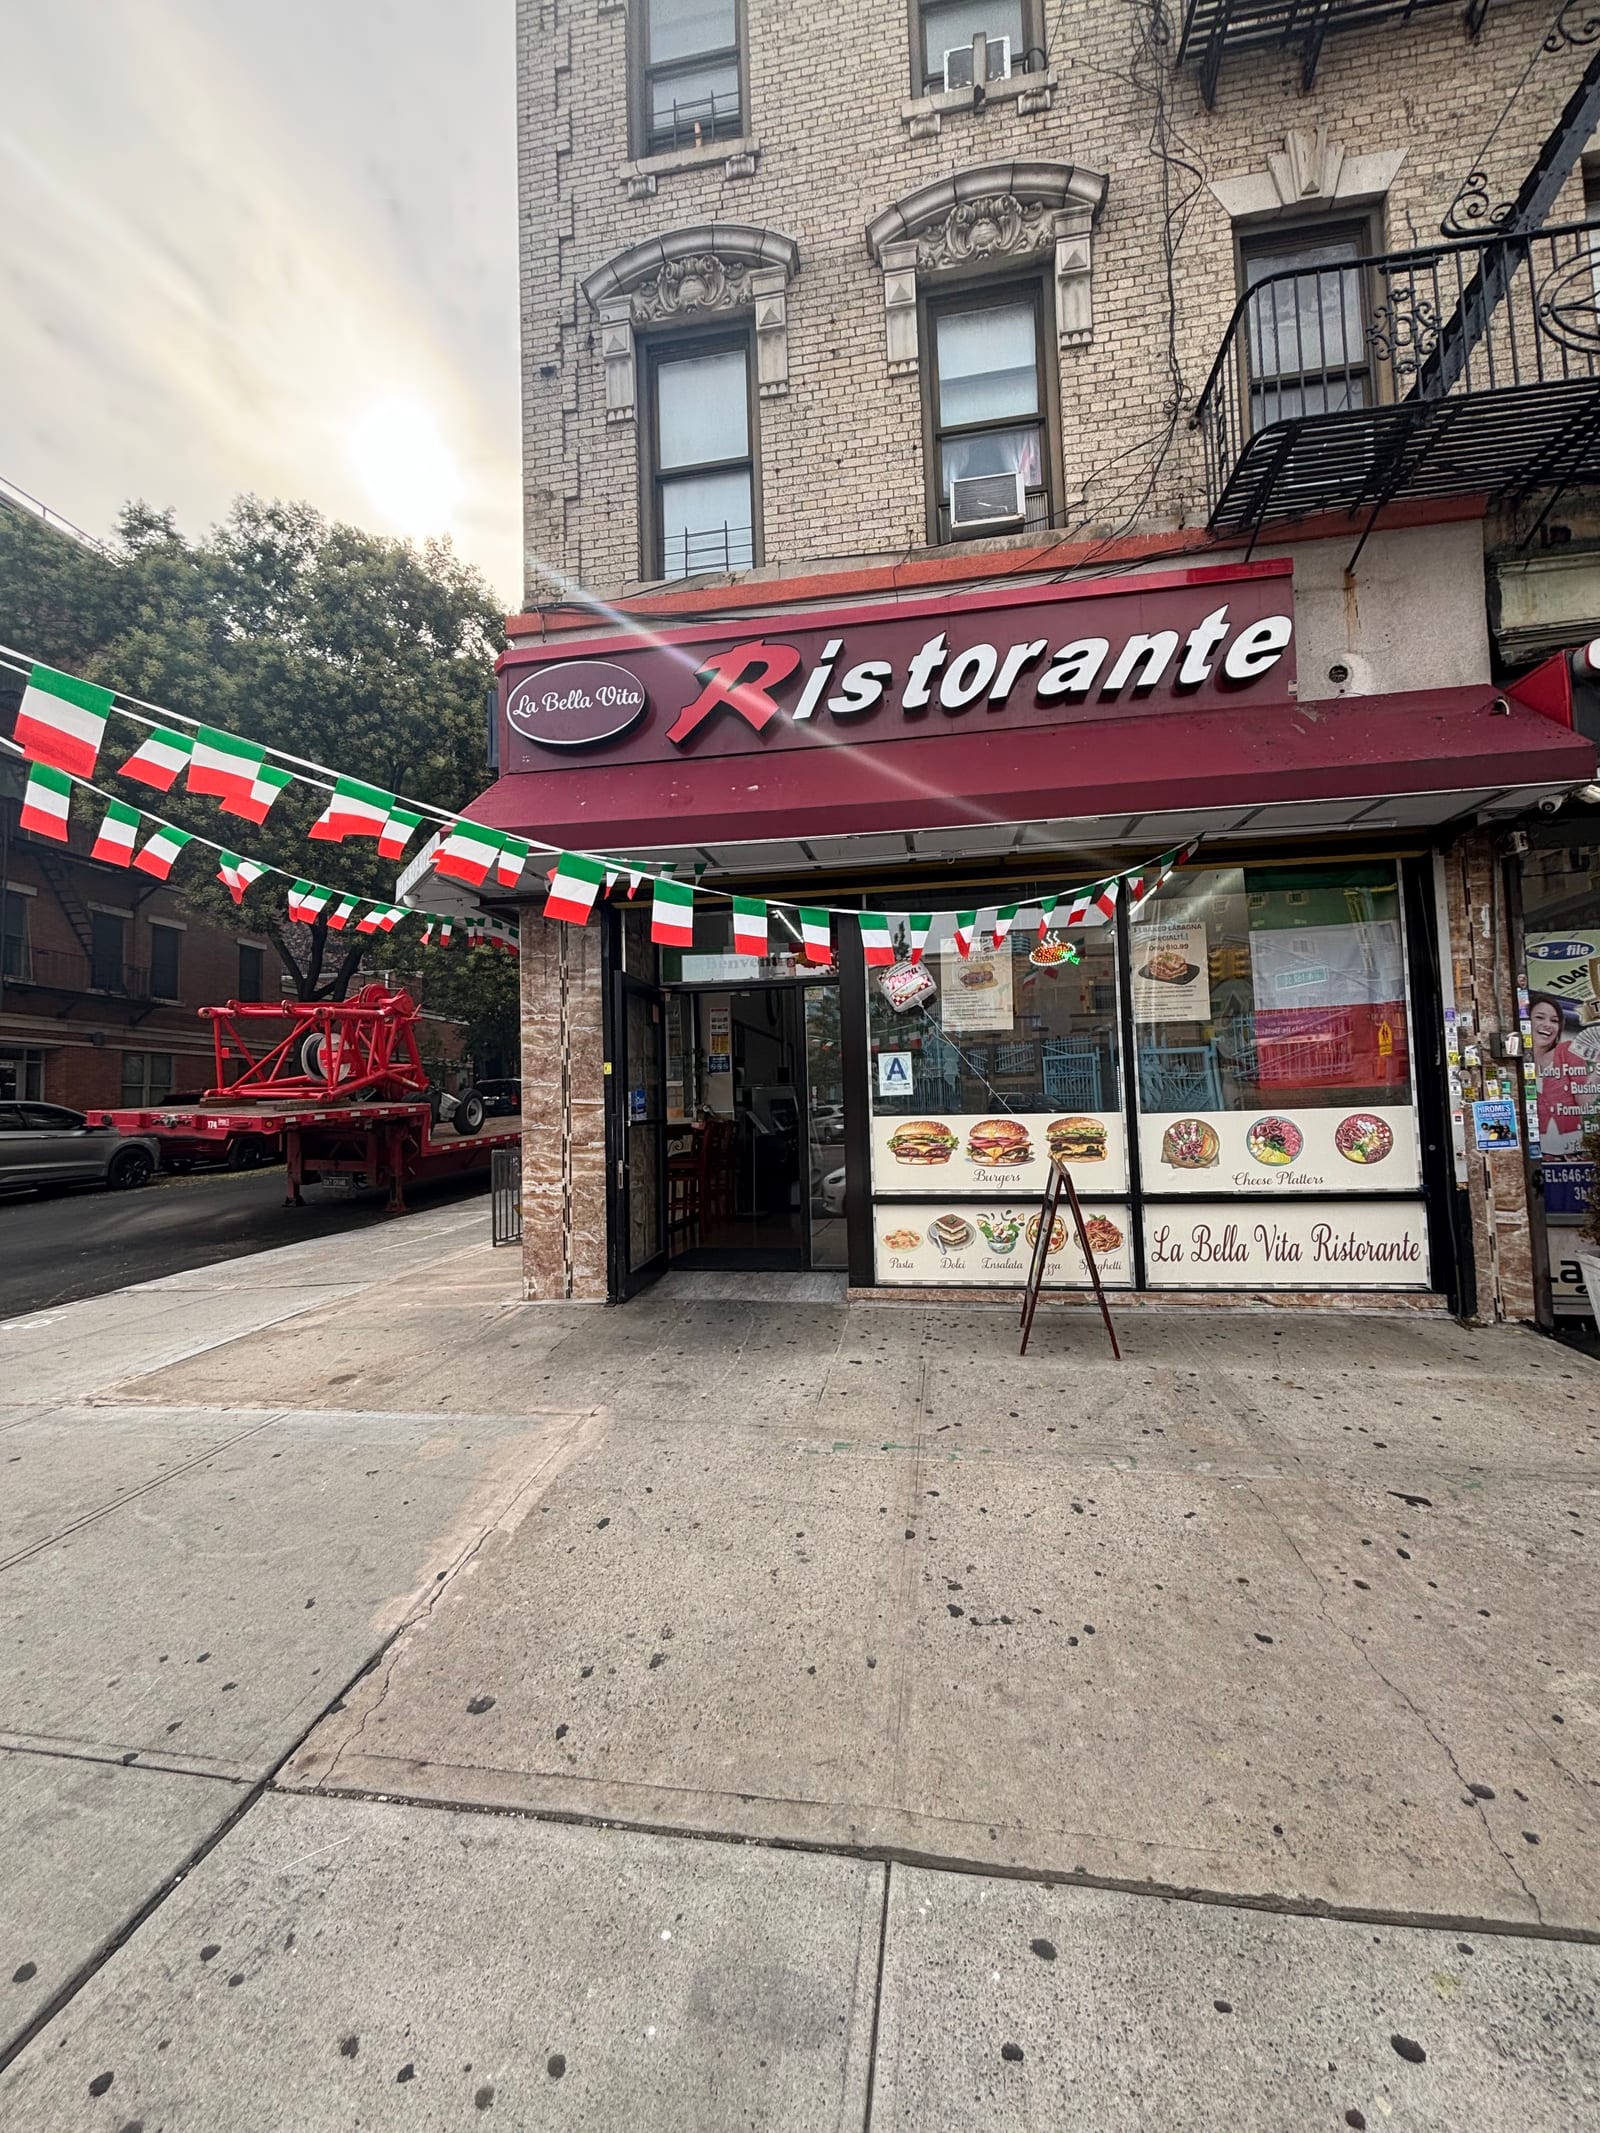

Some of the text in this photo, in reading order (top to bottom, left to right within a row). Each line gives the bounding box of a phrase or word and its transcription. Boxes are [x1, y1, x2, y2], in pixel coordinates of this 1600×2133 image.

[665, 604, 1293, 745] Ristorante
[512, 686, 642, 718] La Bella Vita
[886, 1057, 907, 1081] A
[1562, 1063, 1587, 1076] Form
[972, 1168, 1021, 1189] Burgers
[1231, 1170, 1324, 1186] Cheese Platters
[1151, 1222, 1421, 1262] La Bella Vita Ristorante
[888, 1256, 915, 1270] Pasta
[940, 1256, 966, 1270] Dolci
[980, 1256, 1024, 1270] Ensalata
[1078, 1257, 1122, 1276] Spghetti
